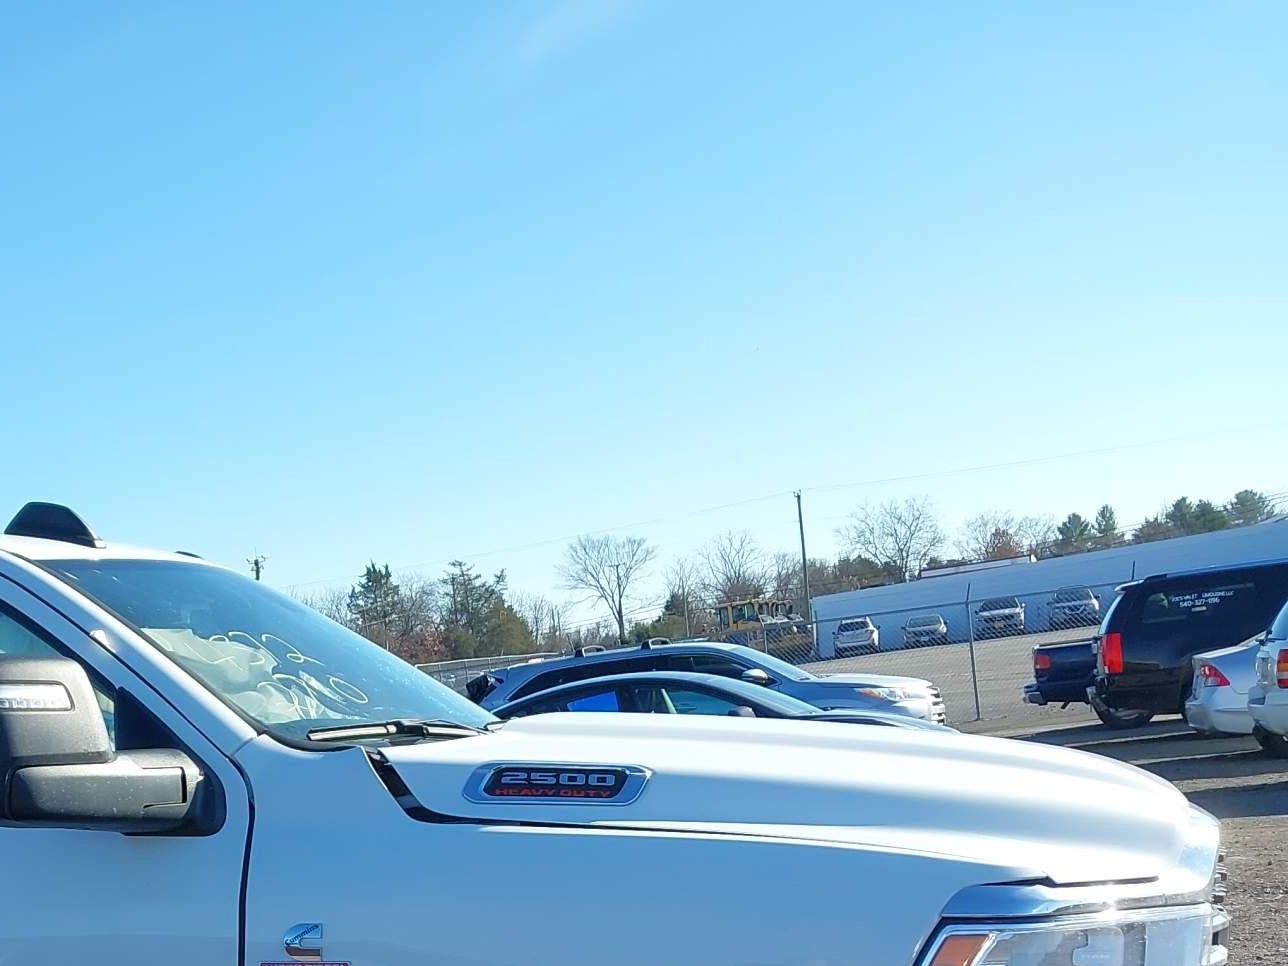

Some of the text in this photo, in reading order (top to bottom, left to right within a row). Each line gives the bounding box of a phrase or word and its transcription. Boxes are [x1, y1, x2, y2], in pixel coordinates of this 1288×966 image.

[500, 771, 616, 786] 2500
[495, 787, 612, 797] HEAVY DUTY
[284, 923, 320, 947] Cummins
